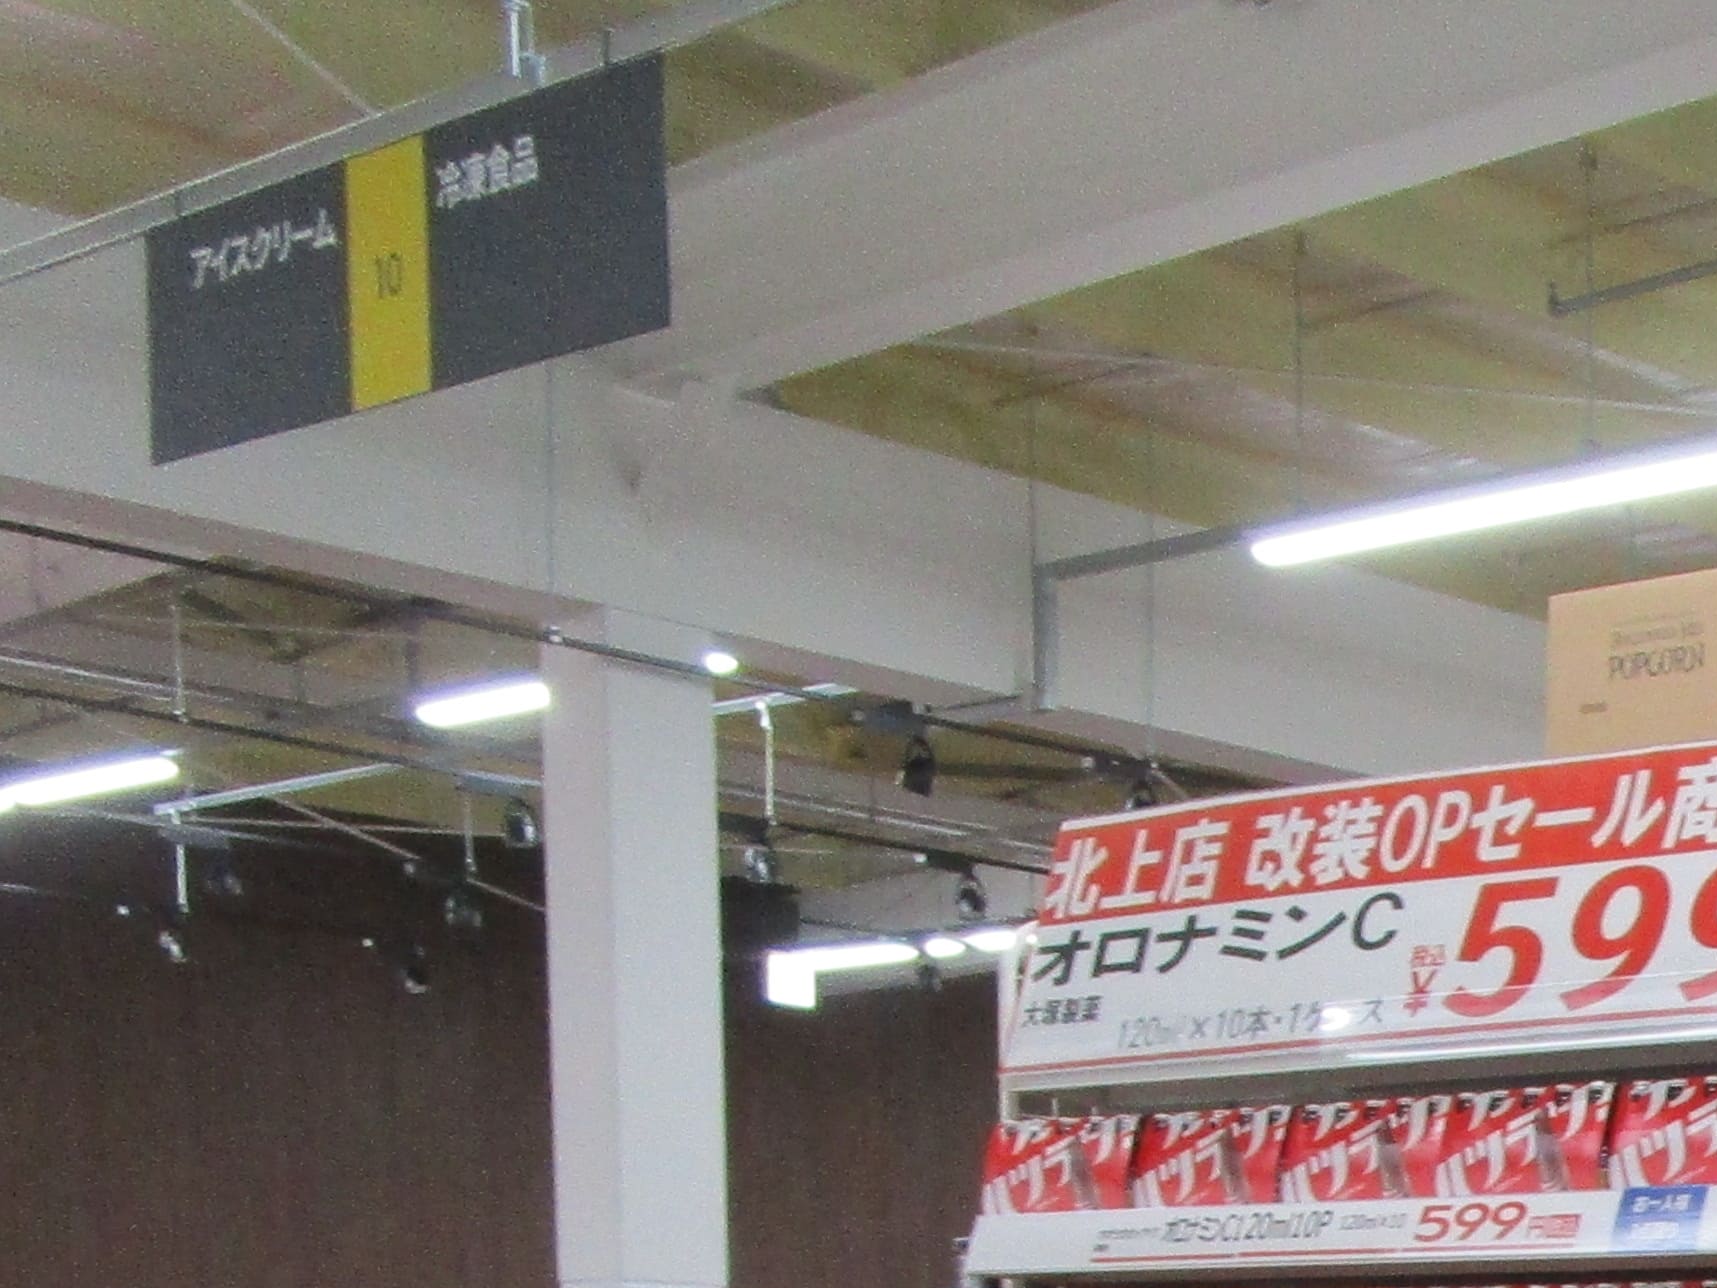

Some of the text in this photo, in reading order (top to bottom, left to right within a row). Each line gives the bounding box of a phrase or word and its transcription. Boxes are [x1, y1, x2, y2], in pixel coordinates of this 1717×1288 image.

[189, 208, 339, 290] アイスクリーム
[1045, 817, 1231, 919] 北上店
[1032, 892, 1405, 986] オロナミンC
